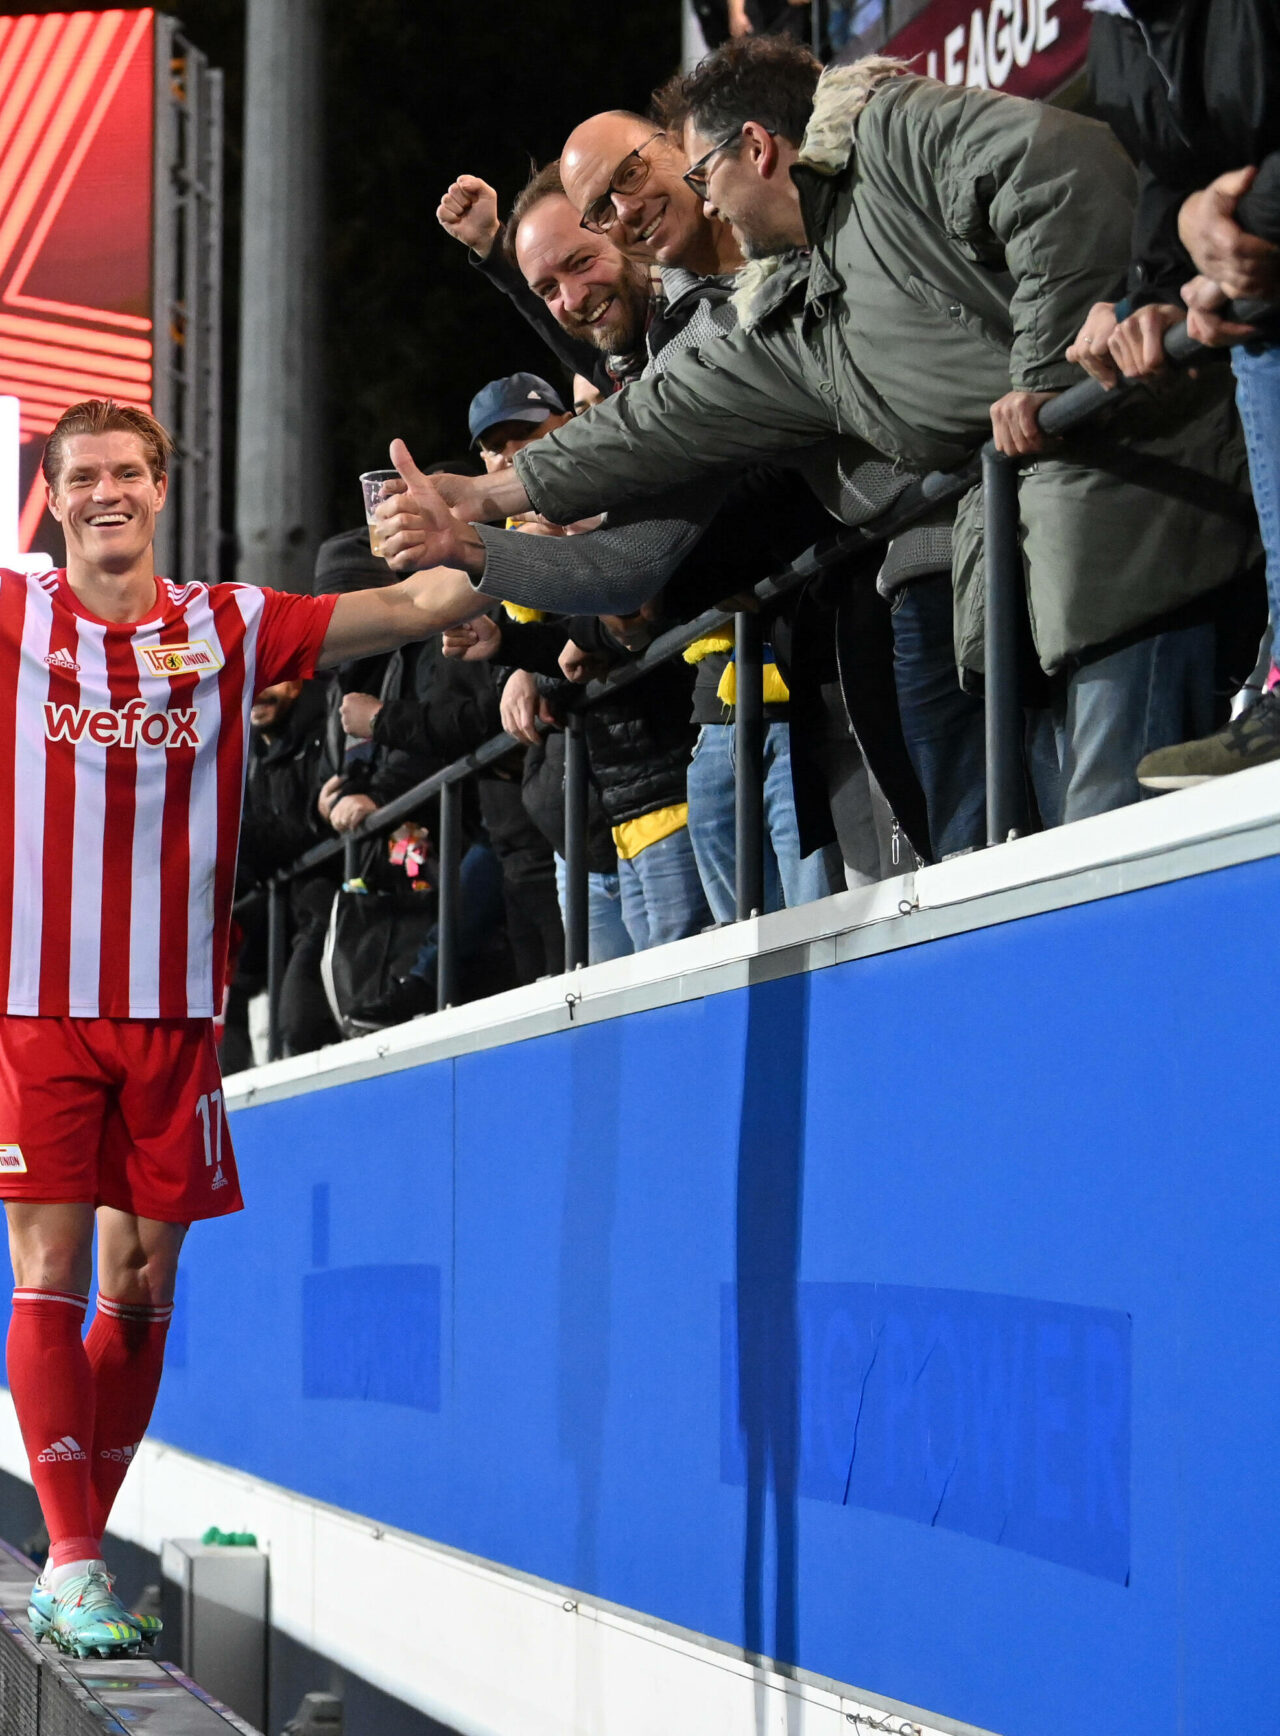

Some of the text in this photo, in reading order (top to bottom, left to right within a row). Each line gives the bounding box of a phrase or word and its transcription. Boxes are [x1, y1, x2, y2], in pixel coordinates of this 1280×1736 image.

[44, 656, 81, 672] adidas
[182, 652, 212, 667] UNION
[42, 699, 203, 748] wefox
[195, 1088, 222, 1167] 17
[37, 1450, 87, 1463] adidas
